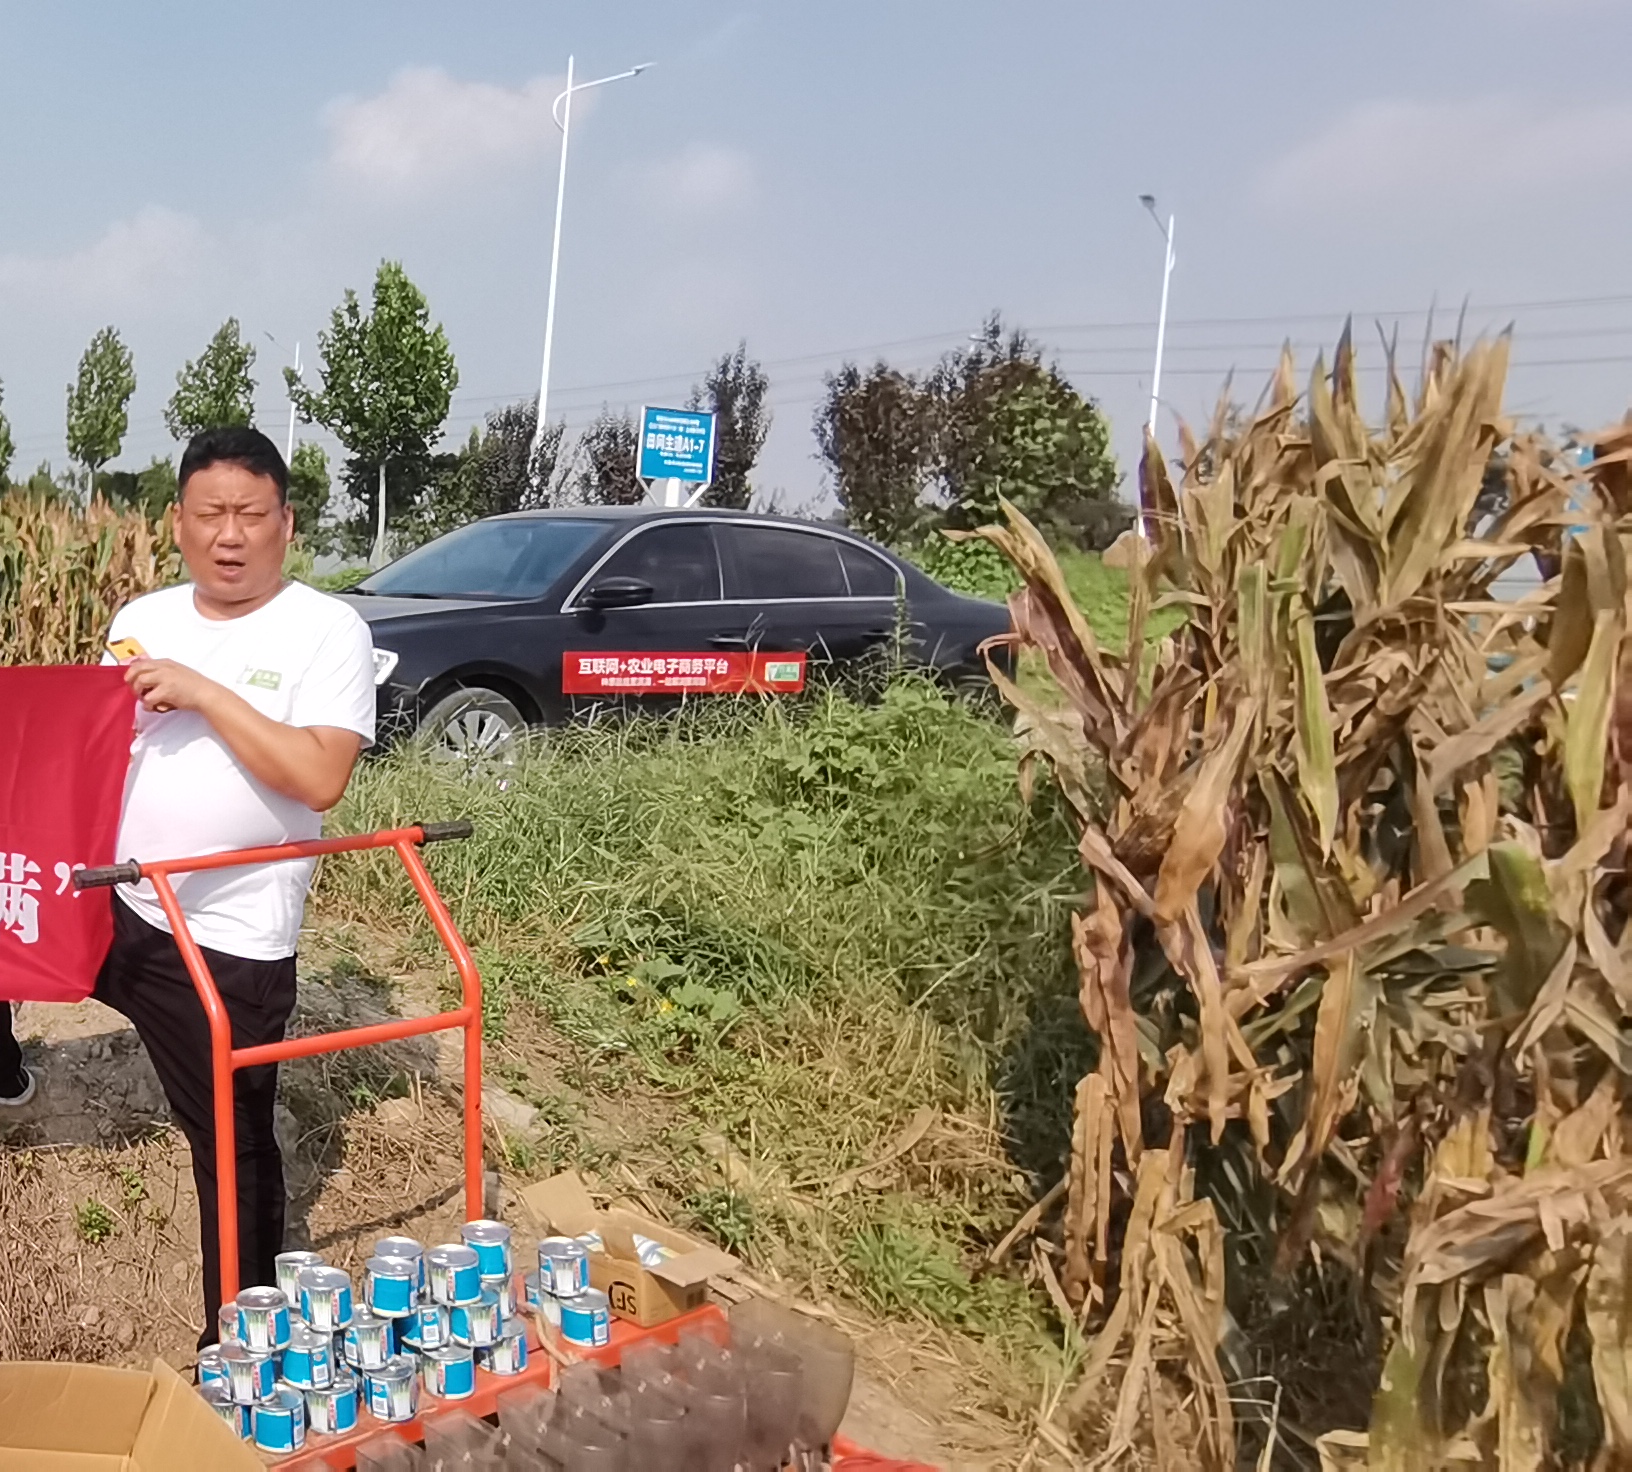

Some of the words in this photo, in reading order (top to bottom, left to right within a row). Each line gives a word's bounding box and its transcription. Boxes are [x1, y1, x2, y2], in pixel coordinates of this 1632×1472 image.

[578, 658, 729, 675] 互联网+农业电子商务平台
